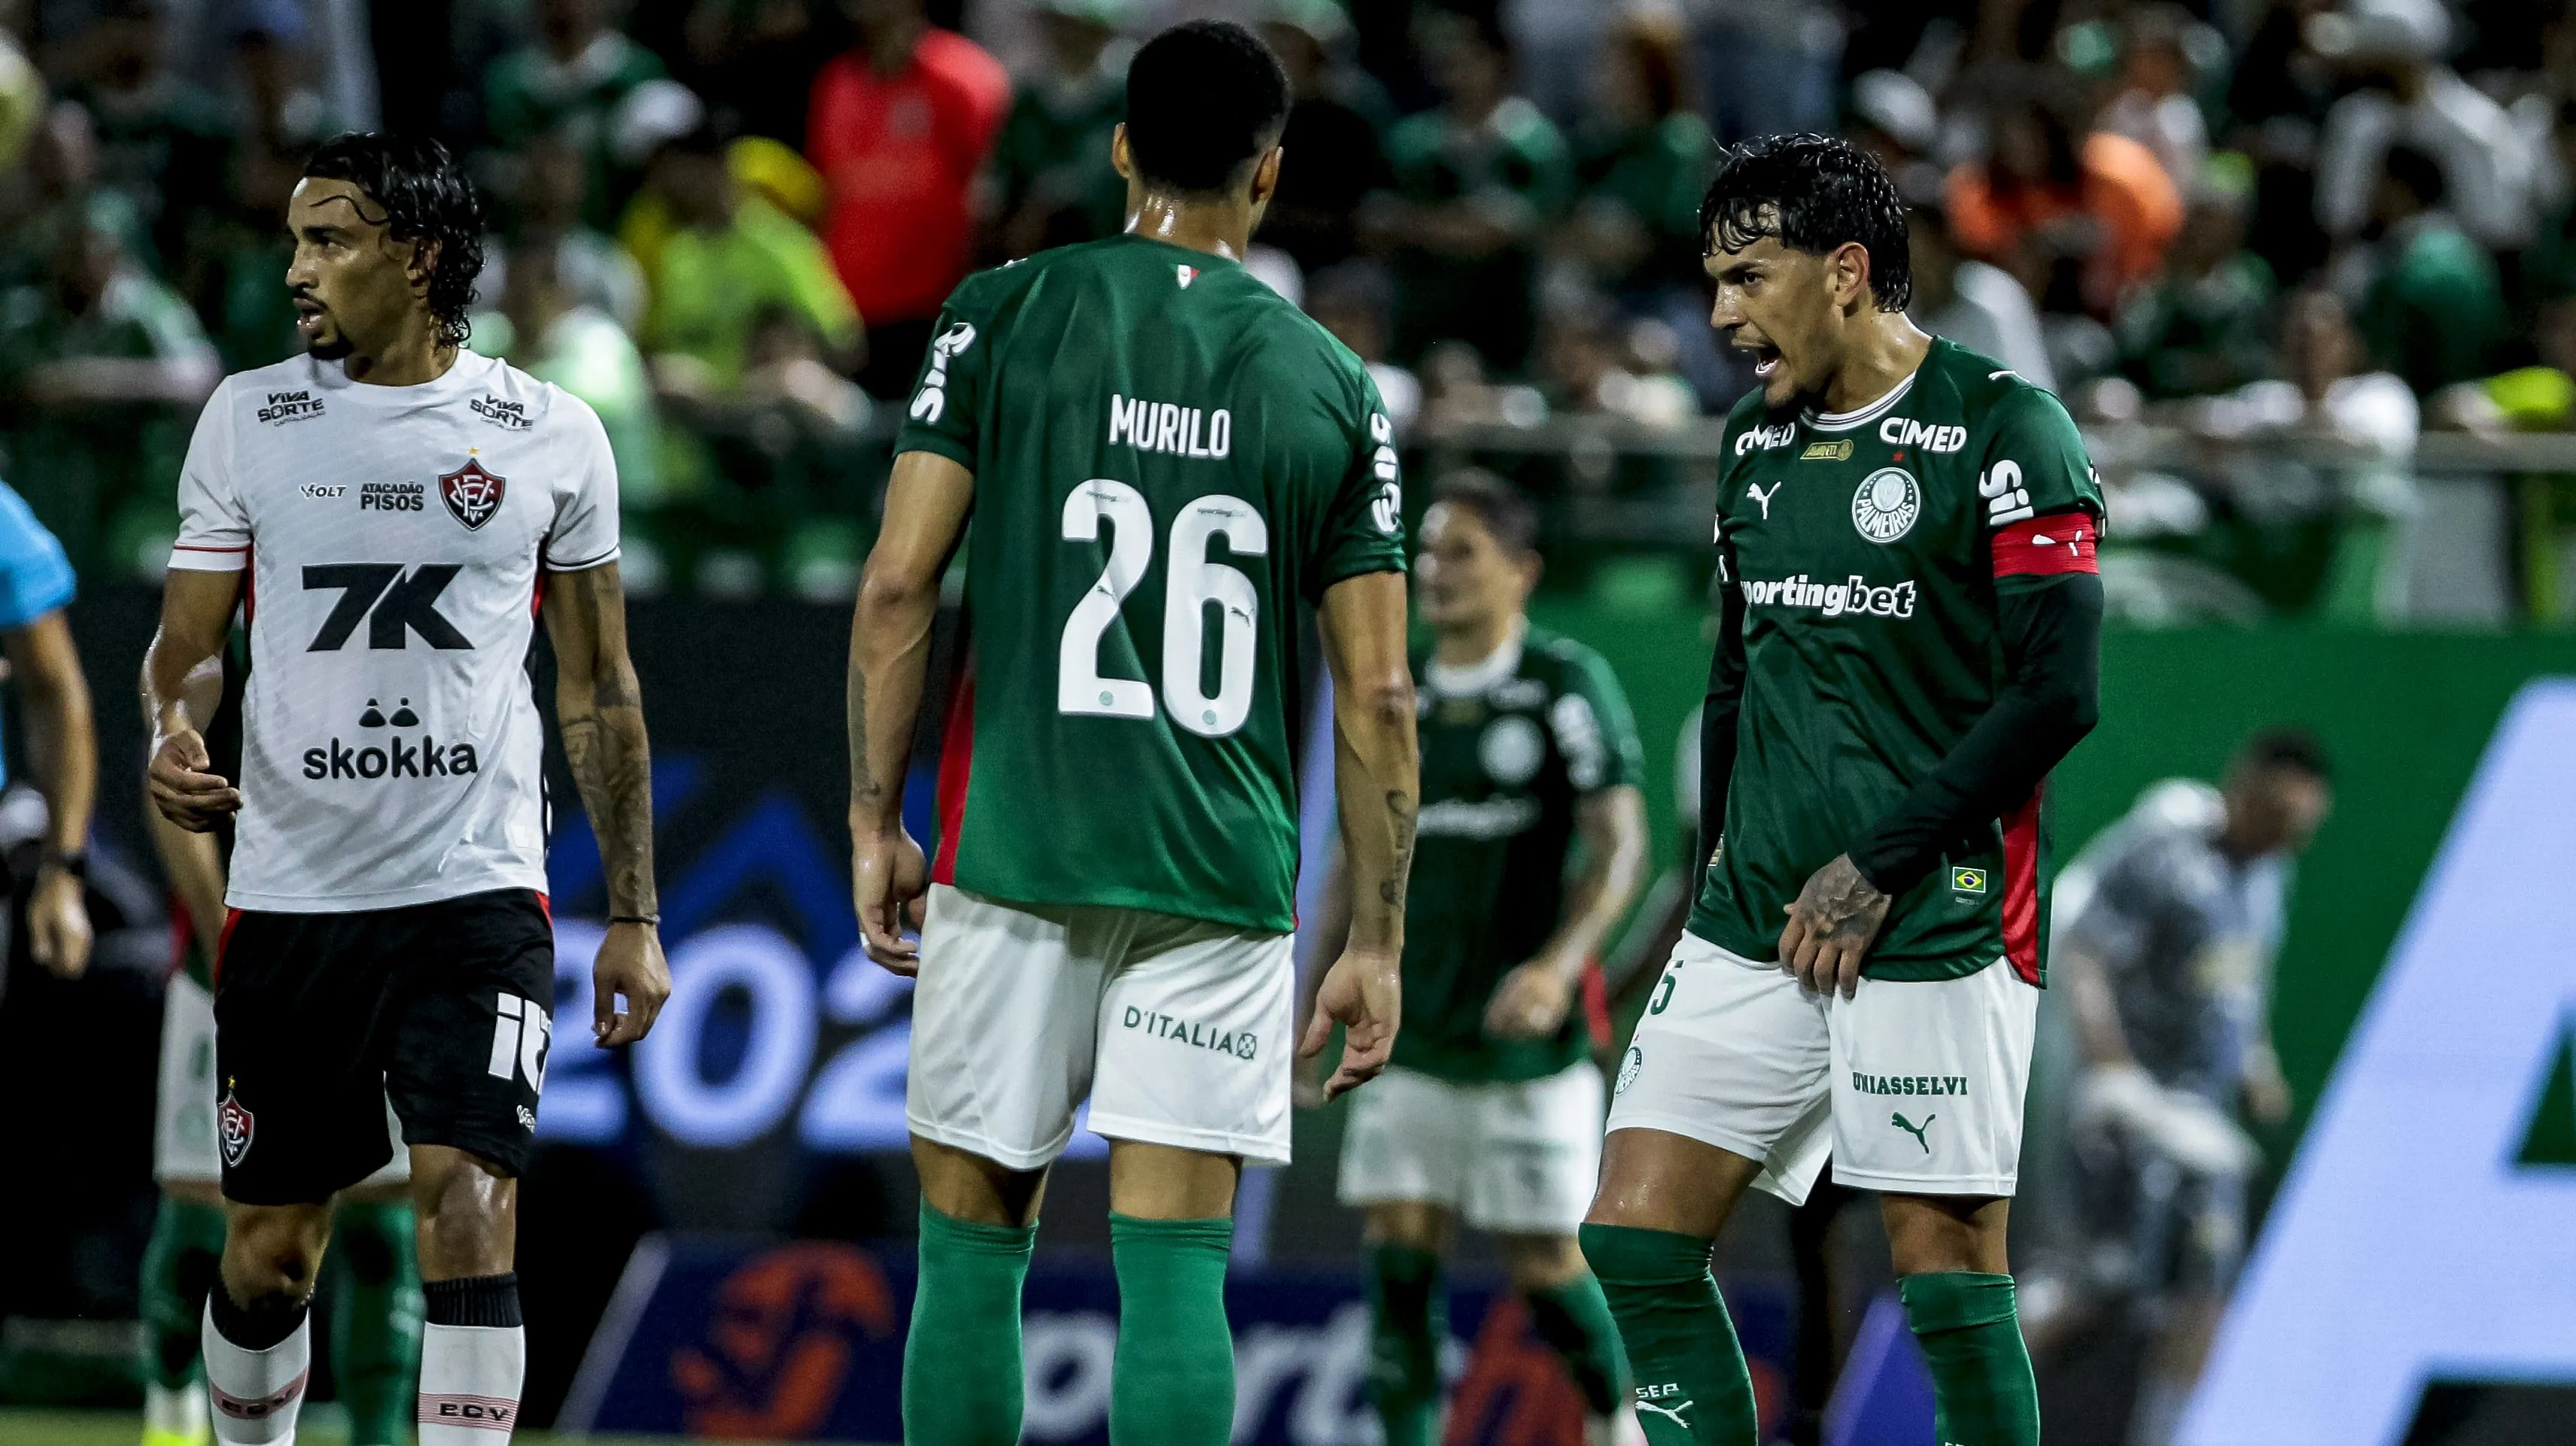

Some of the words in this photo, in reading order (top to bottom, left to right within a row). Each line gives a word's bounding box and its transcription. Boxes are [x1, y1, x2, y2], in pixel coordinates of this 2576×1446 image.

[257, 398, 325, 423] SORTE
[267, 390, 309, 406] VIVA
[470, 398, 534, 427] SORTE
[485, 393, 525, 415] VIVA
[1108, 393, 1231, 460] MURILO
[1879, 416, 1968, 454] CIMED
[360, 481, 425, 494] ATACADÃO
[360, 493, 425, 512] PISOS
[1856, 498, 1915, 538] PALMEIRAS
[302, 563, 476, 652] 7K
[1057, 478, 1269, 738] 26
[1740, 573, 1918, 618] portingbet
[302, 735, 479, 781] skokka
[1650, 959, 1684, 1016] 5
[1124, 1004, 1233, 1055] D'ITALIA
[1852, 1071, 1968, 1095] UNIASSELVI
[1635, 1383, 1680, 1398] SEP
[439, 1402, 509, 1421] ECV
